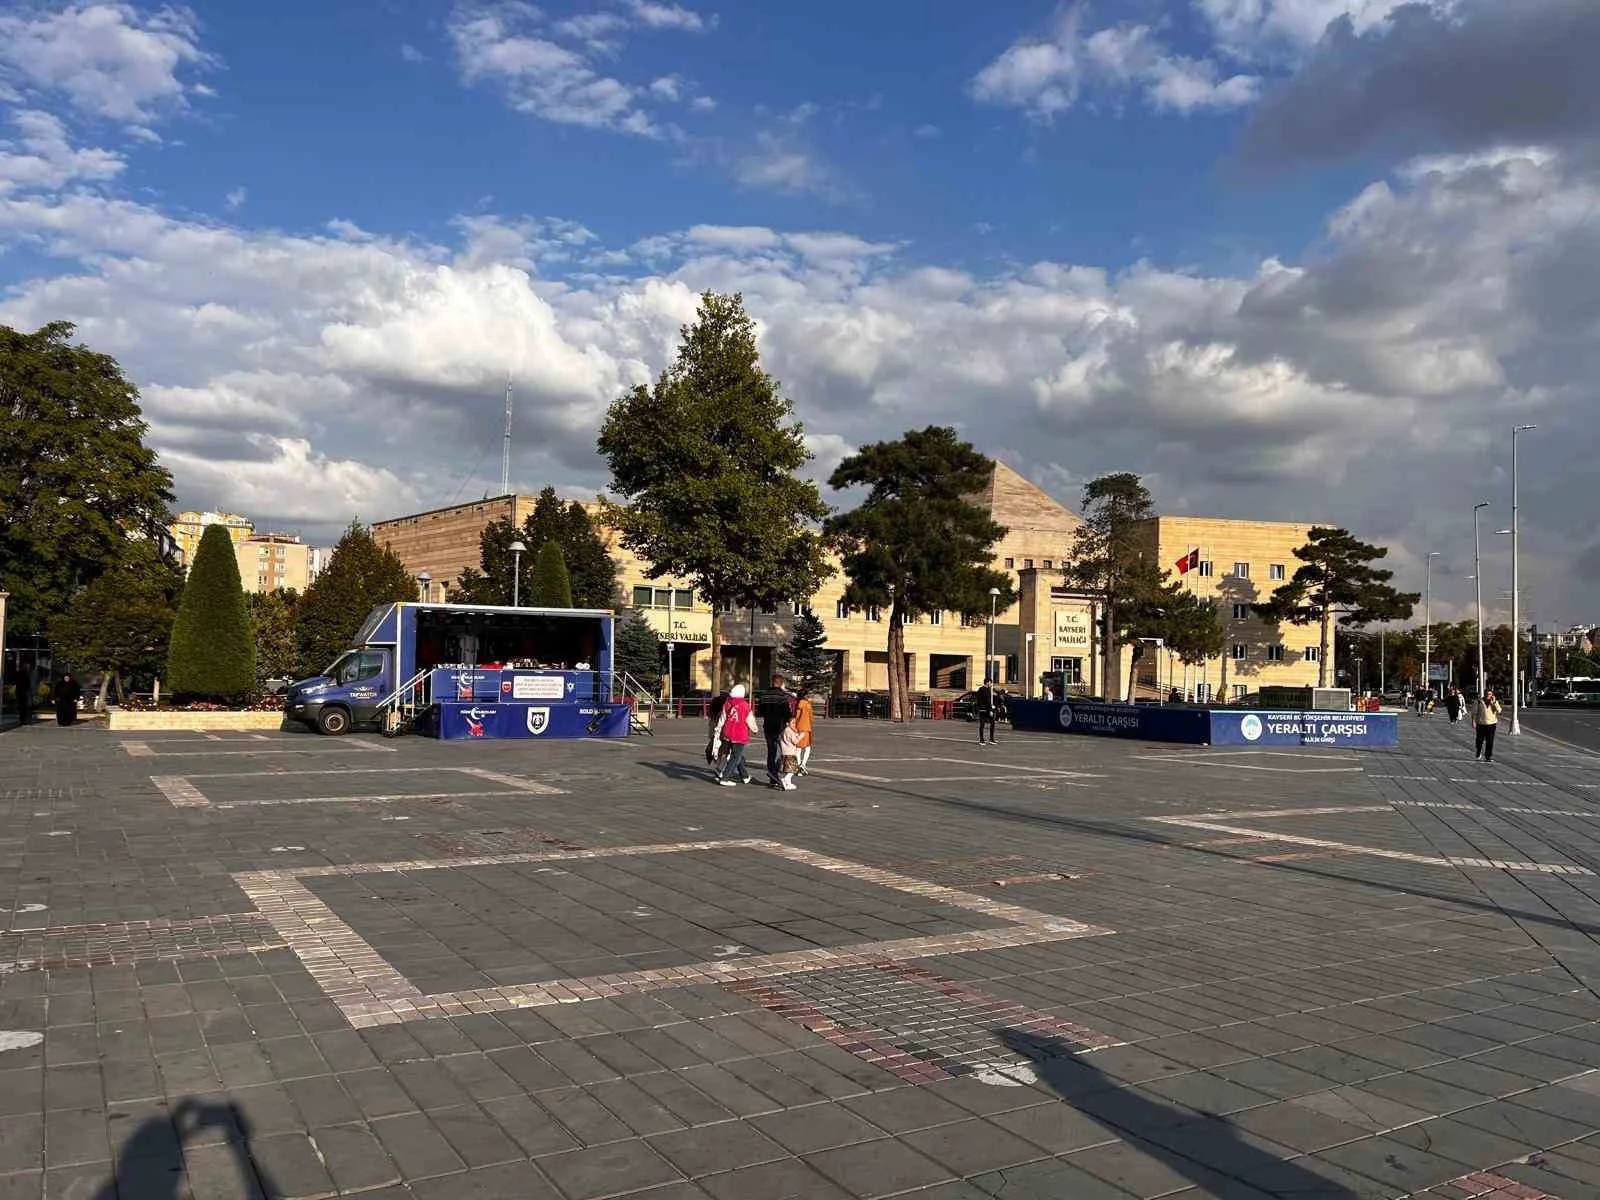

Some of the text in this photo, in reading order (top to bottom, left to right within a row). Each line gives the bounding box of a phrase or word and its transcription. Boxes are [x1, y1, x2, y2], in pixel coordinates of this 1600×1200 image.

[673, 621, 687, 629] T.C.
[1074, 711, 1105, 725] YERALTI
[1267, 724, 1367, 738] YERALTI ÇARŞISI
